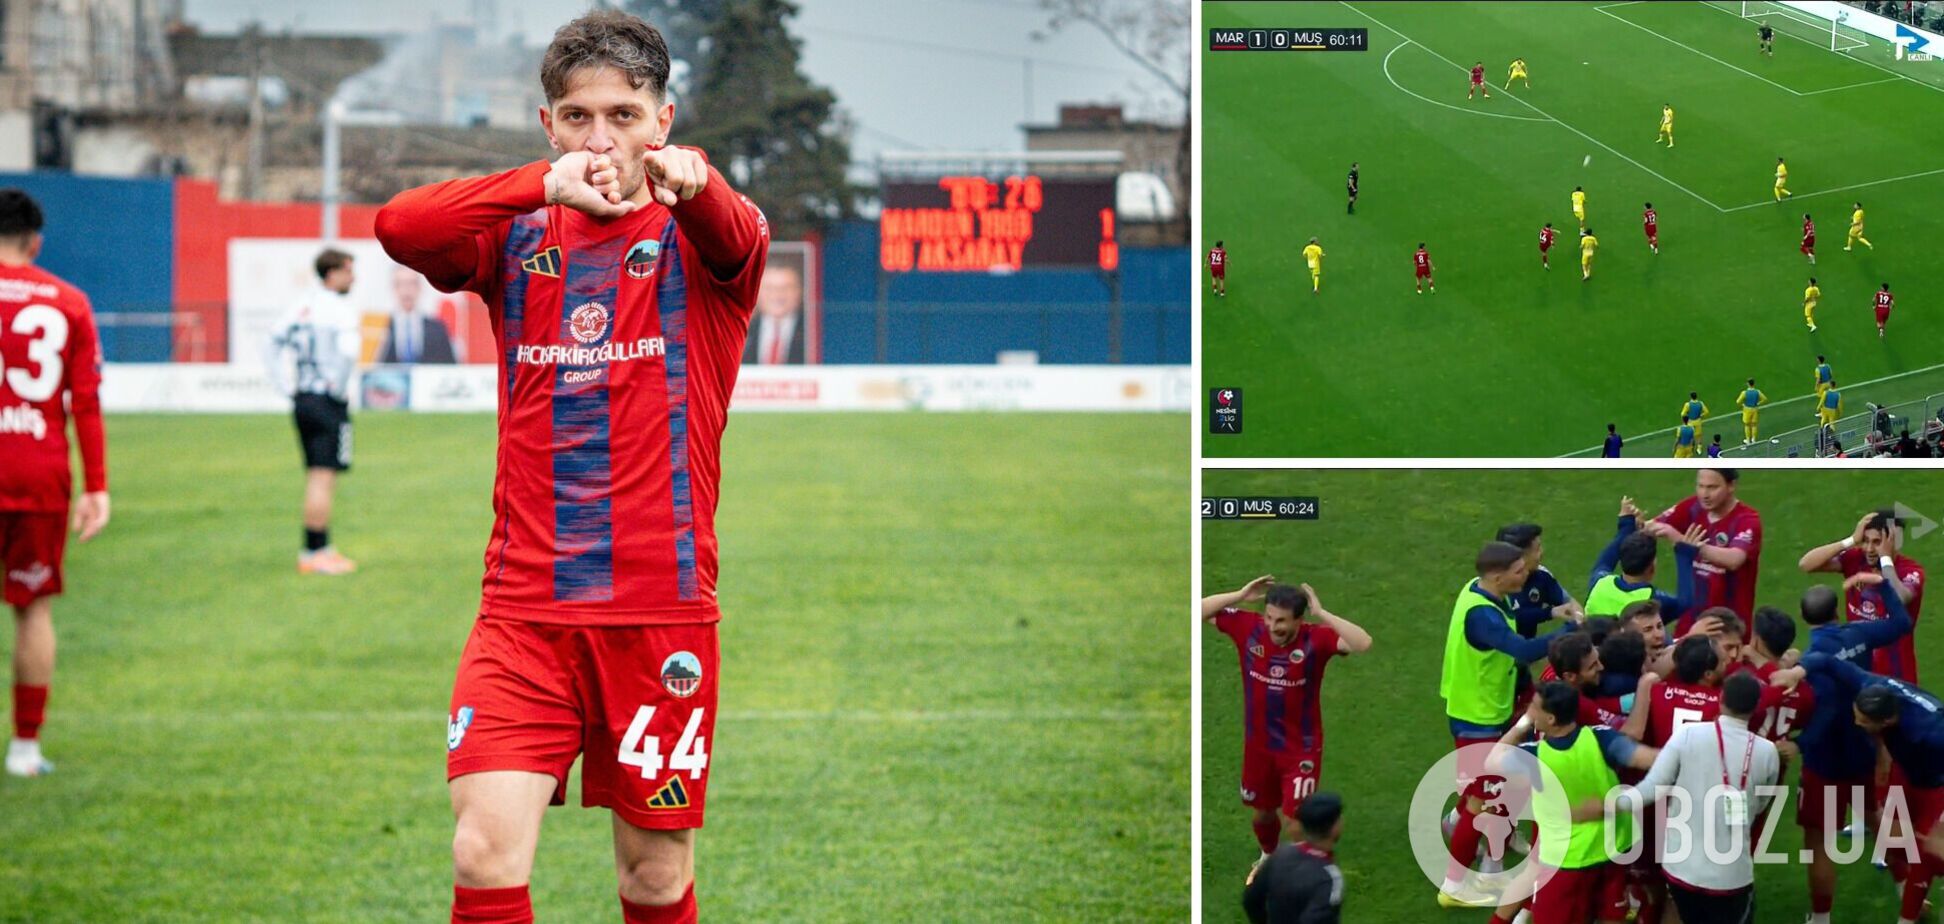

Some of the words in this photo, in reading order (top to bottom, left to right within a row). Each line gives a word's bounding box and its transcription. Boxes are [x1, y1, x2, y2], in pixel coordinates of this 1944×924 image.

[1418, 255, 1425, 264] 8
[1879, 294, 1889, 304] 19
[0, 304, 69, 402] 3
[563, 368, 602, 383] GROUP
[617, 704, 709, 780] 44
[1292, 776, 1316, 800] 10
